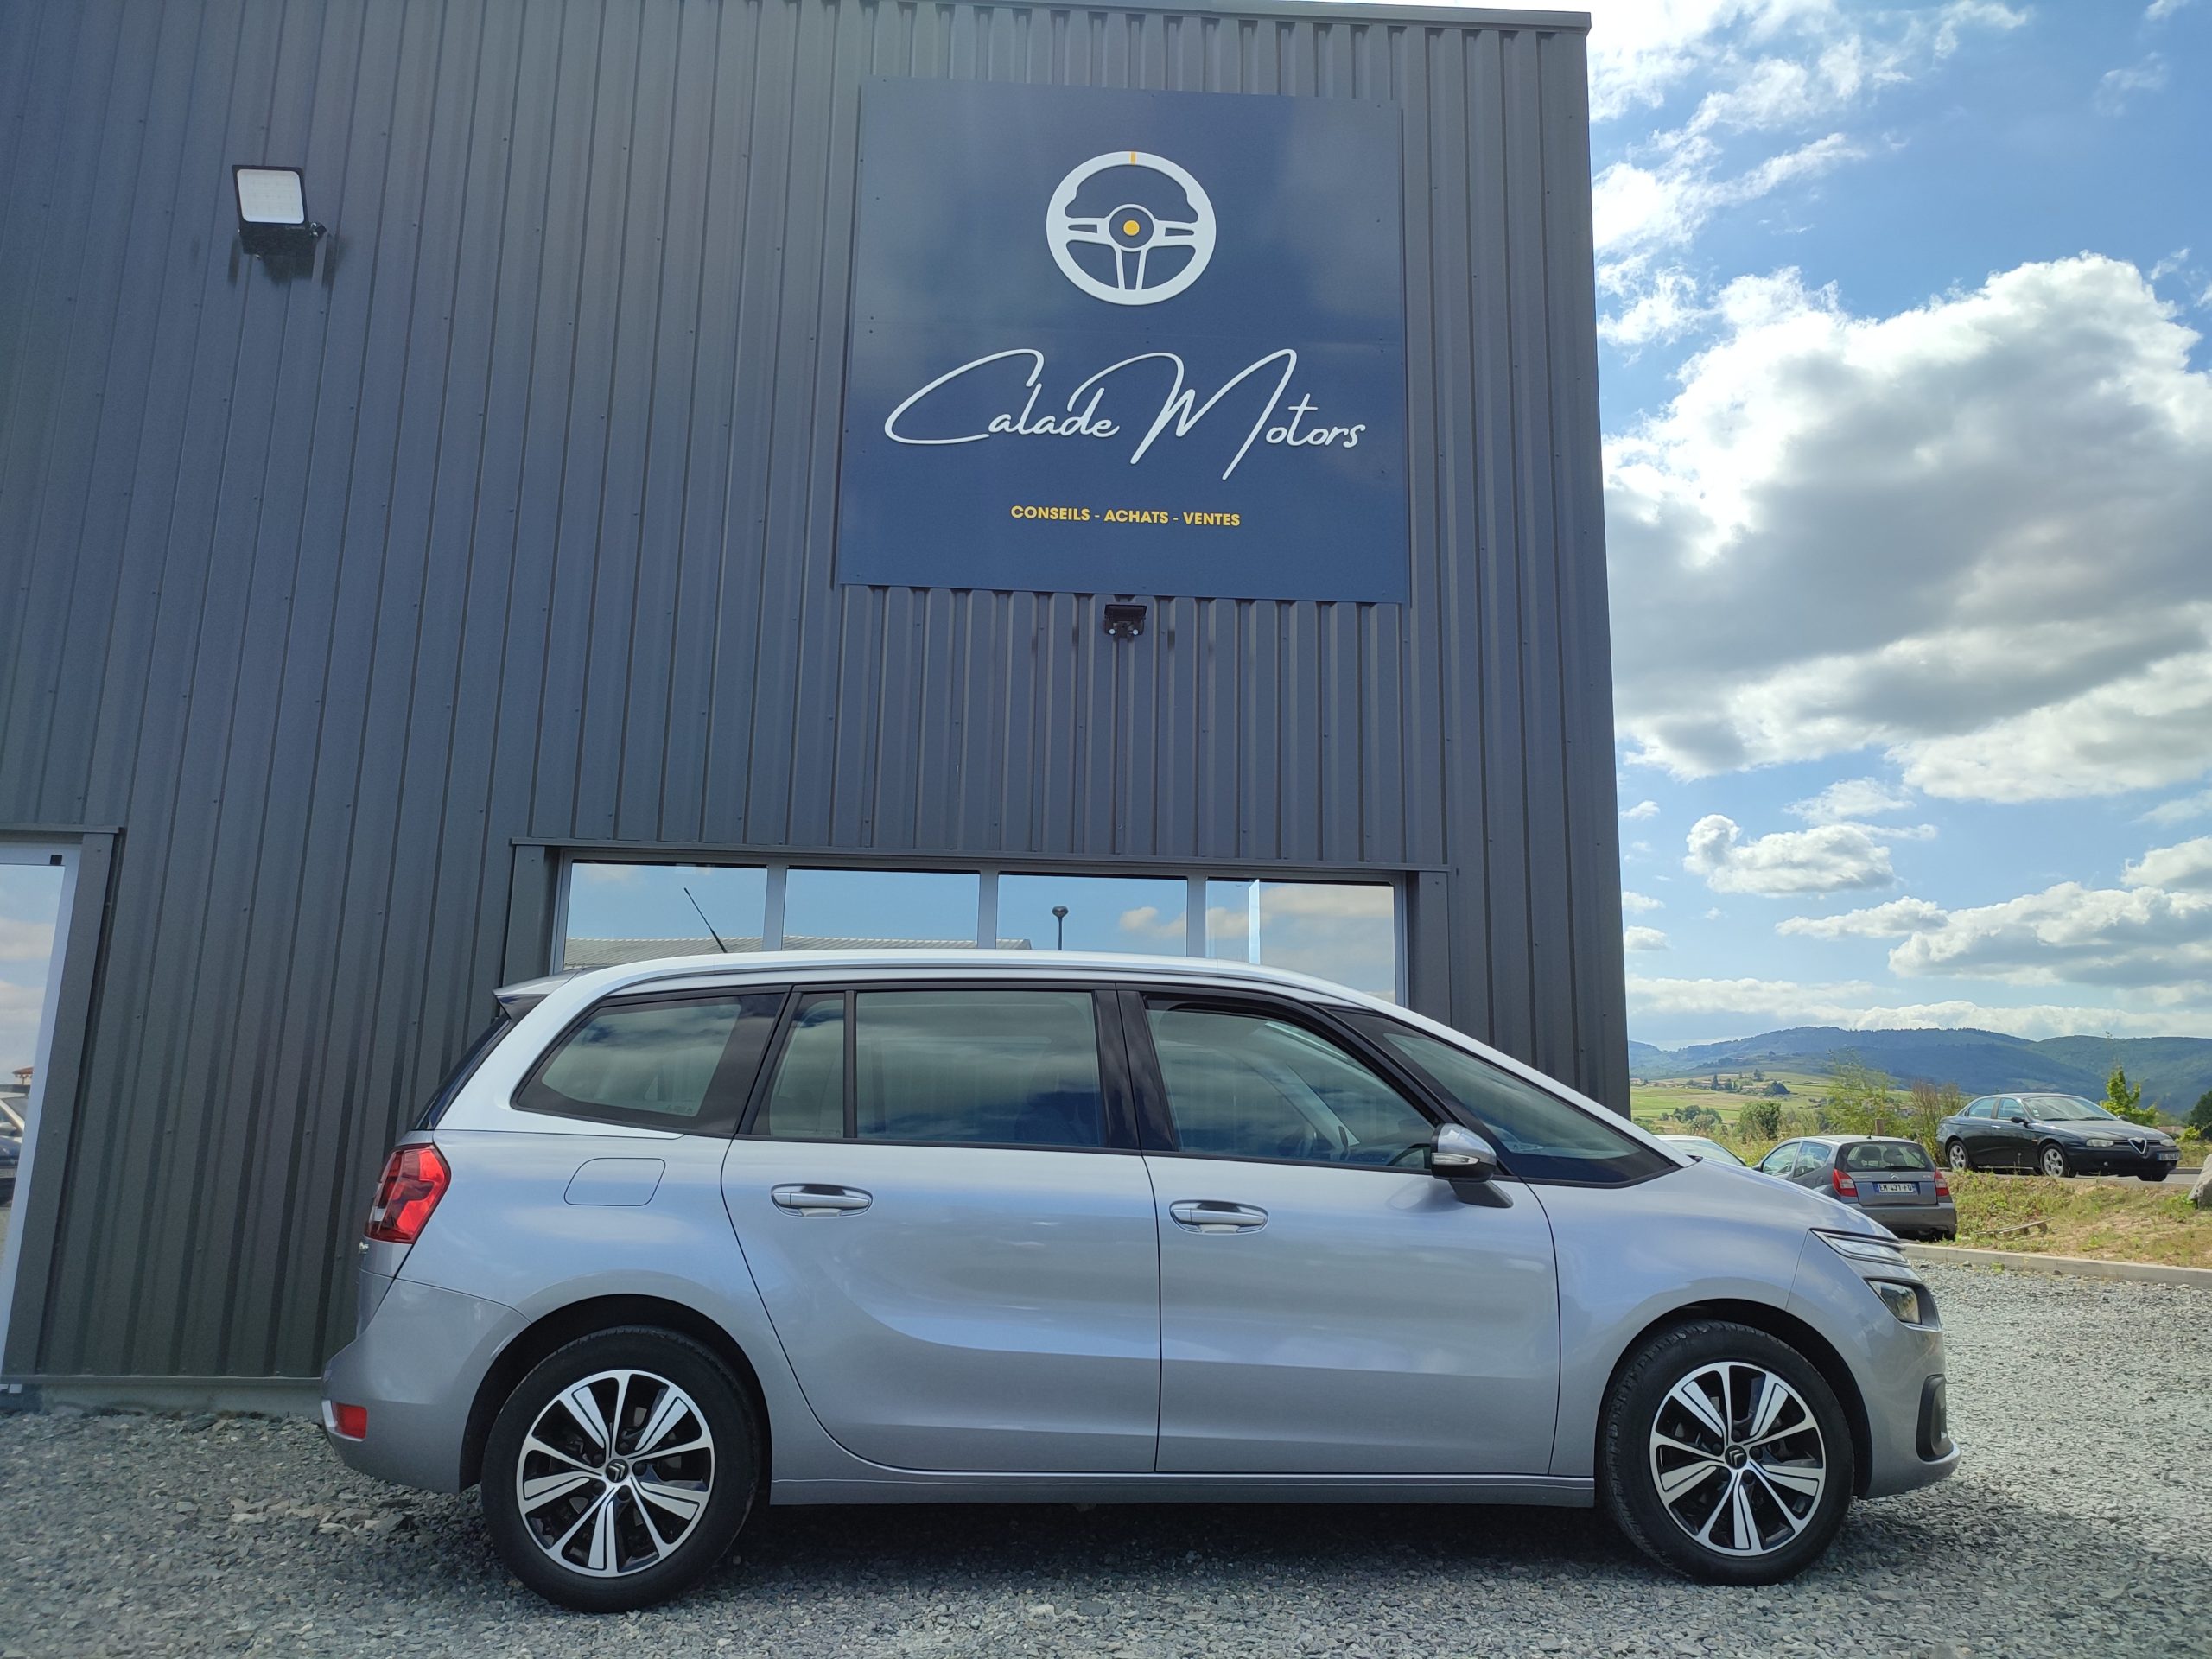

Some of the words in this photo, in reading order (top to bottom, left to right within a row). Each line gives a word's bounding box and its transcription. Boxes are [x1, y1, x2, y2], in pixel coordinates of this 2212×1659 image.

[884, 348, 1120, 445] Calade
[1067, 348, 1366, 480] Motors
[1010, 505, 1090, 522] CONSEILS
[1103, 508, 1170, 524] ACHATS
[1182, 511, 1241, 527] VENTES
